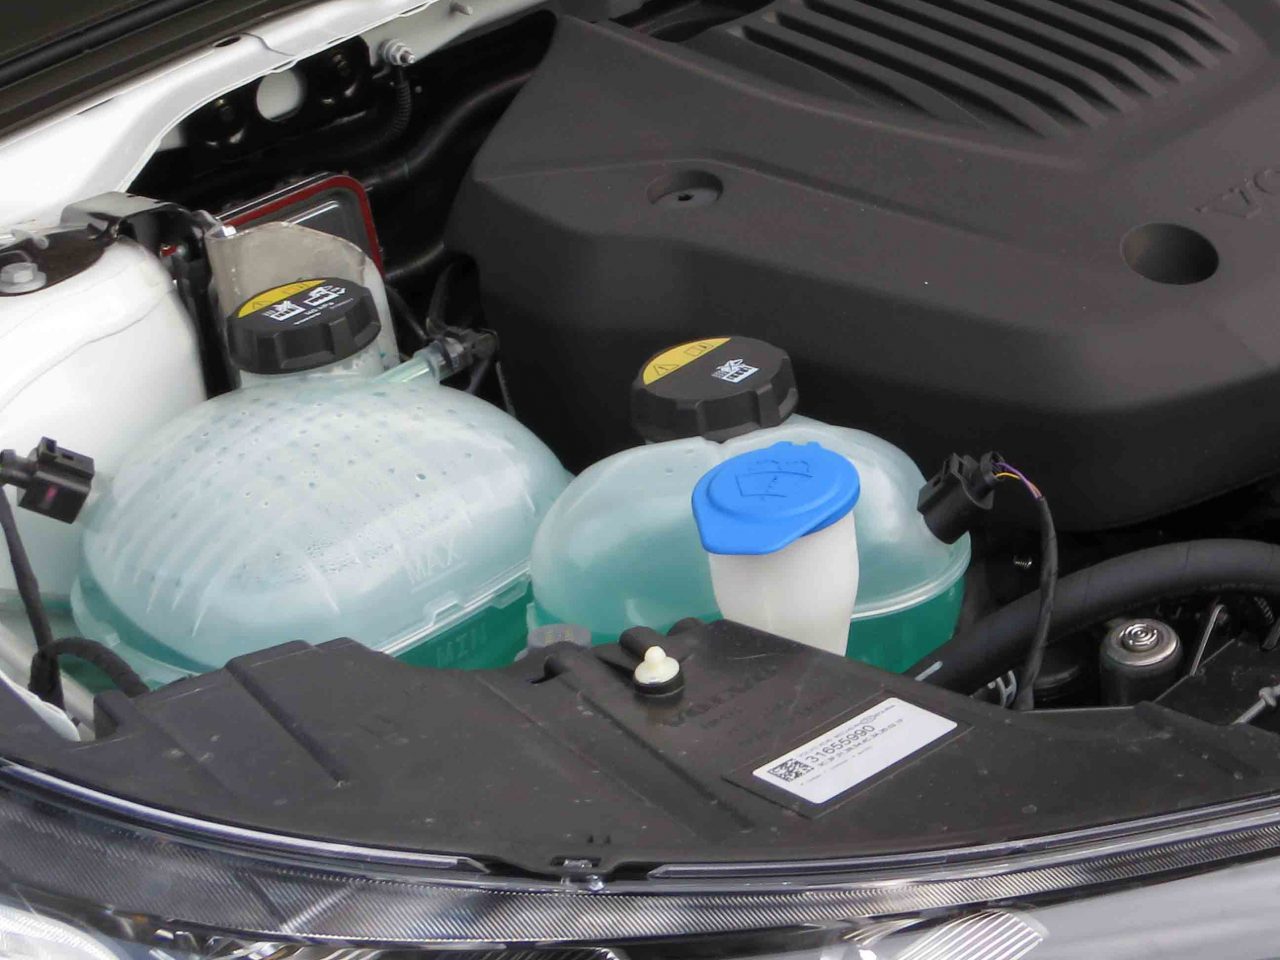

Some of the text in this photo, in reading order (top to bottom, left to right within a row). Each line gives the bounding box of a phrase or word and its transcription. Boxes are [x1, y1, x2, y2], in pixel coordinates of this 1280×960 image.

[404, 538, 463, 586] MAX
[435, 622, 489, 669] MIN
[804, 724, 876, 765] 31655990
